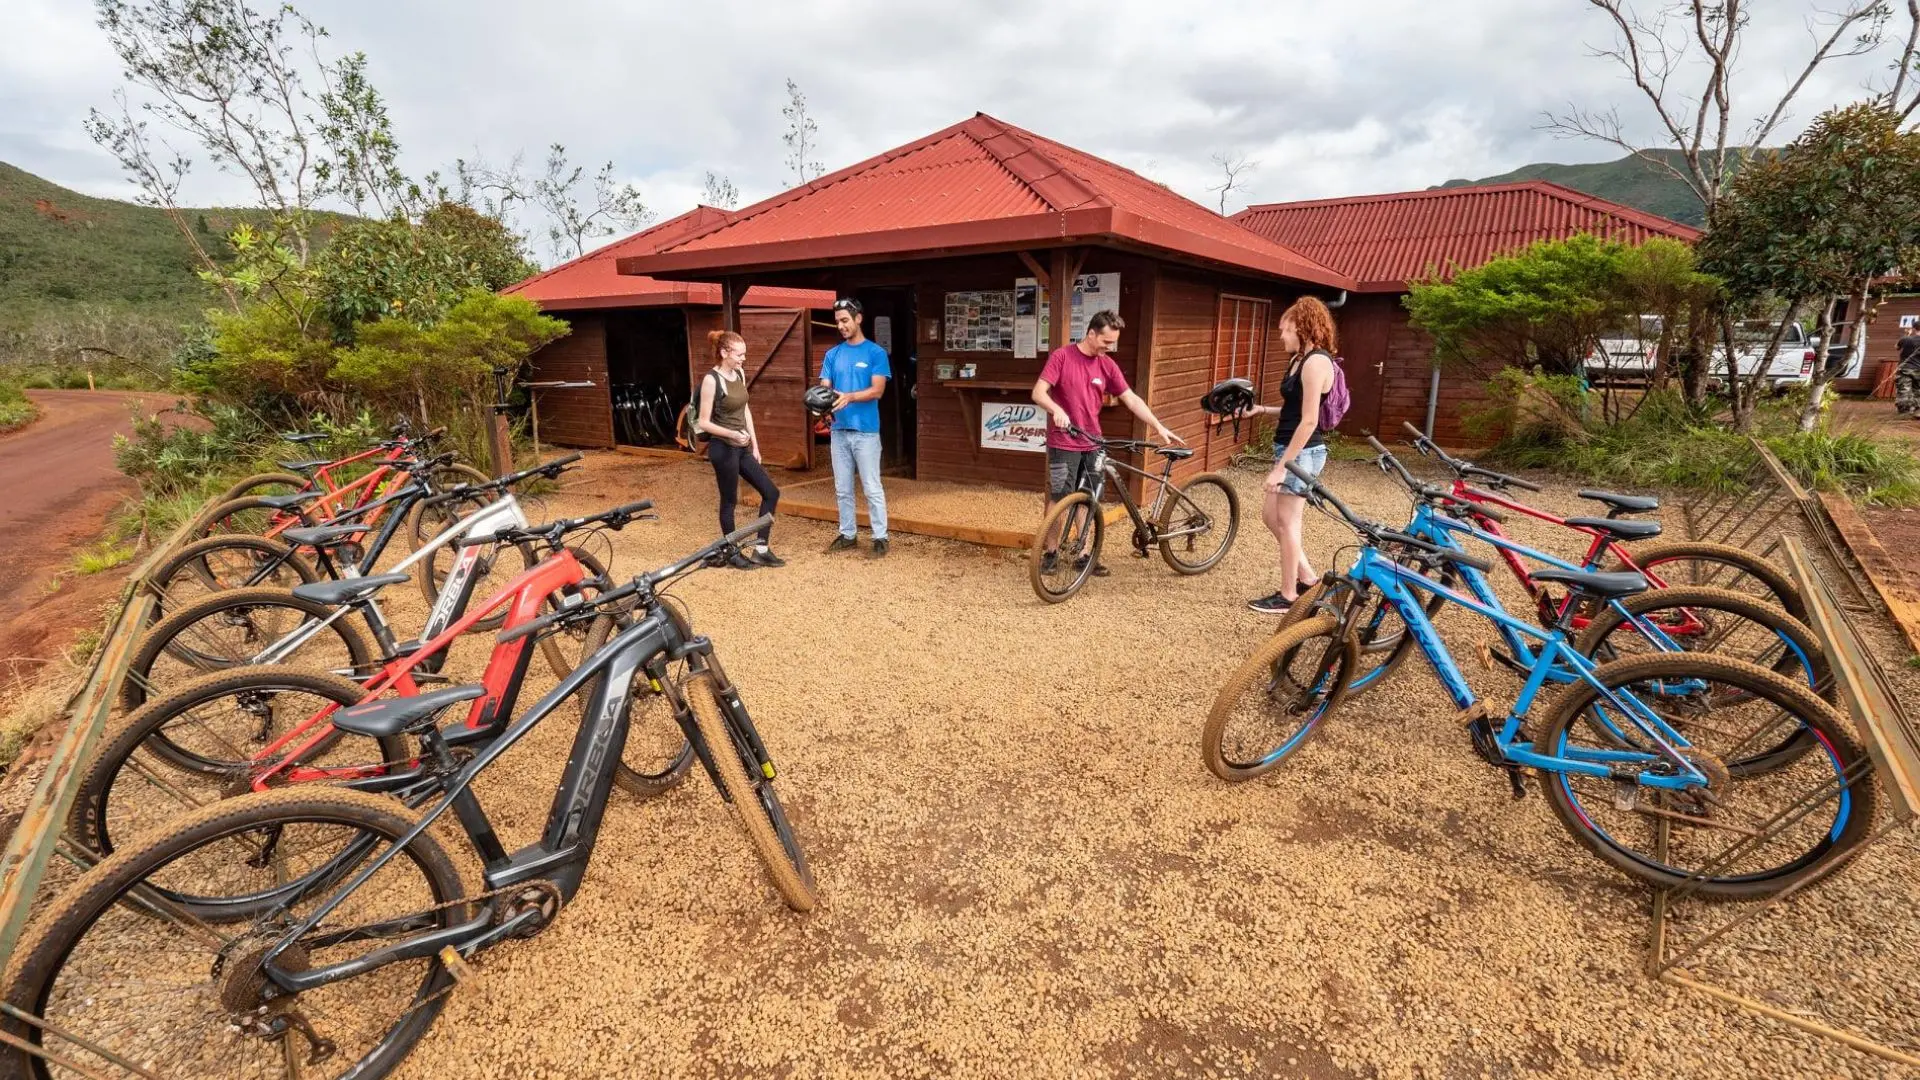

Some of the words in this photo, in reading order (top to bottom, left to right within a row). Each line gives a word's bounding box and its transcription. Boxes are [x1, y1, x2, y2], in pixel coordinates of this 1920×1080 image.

[994, 405, 1036, 424] SUD
[1009, 427, 1047, 438] LOISIR
[1399, 601, 1465, 702] ORBEA
[86, 795, 99, 848] ENDA
